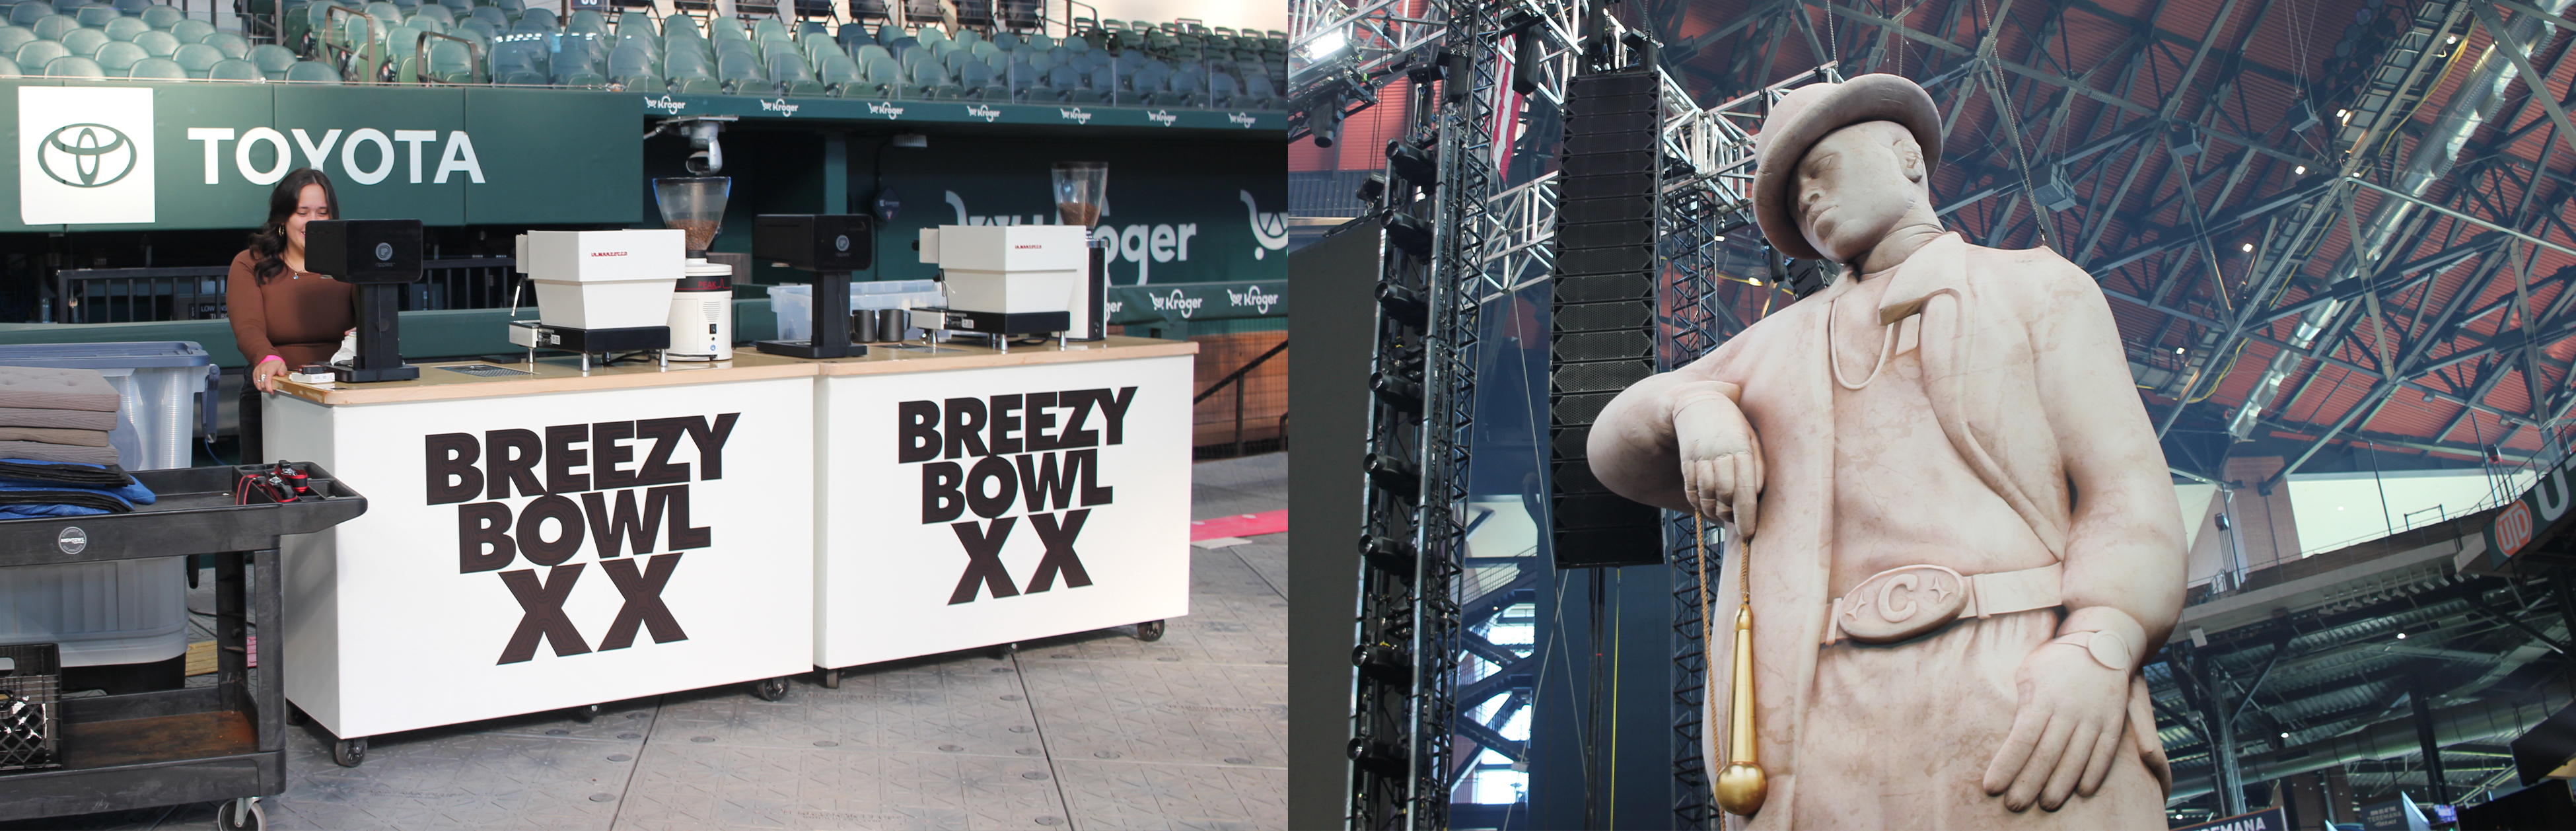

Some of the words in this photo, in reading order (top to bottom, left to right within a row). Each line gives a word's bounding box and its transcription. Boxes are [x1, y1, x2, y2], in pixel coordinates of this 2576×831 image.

[658, 95, 686, 115] Kroger
[773, 98, 799, 117] Kroger
[879, 101, 904, 120] Kroger
[978, 104, 1001, 122] Kroger
[1070, 107, 1092, 125] Kroger
[1157, 110, 1177, 127] Kroger
[188, 127, 485, 185] TOYOTA
[698, 281, 717, 289] PEAK
[1166, 289, 1202, 318] Kroger
[1243, 285, 1278, 314] Kroger
[1106, 301, 1123, 322] ger
[899, 386, 1138, 464] BREEZY
[425, 412, 741, 505] BREEZY
[922, 449, 1113, 524] BOWL
[458, 484, 711, 574] BOWL
[1878, 573, 1918, 622] C
[2193, 816, 2266, 831] MANA
